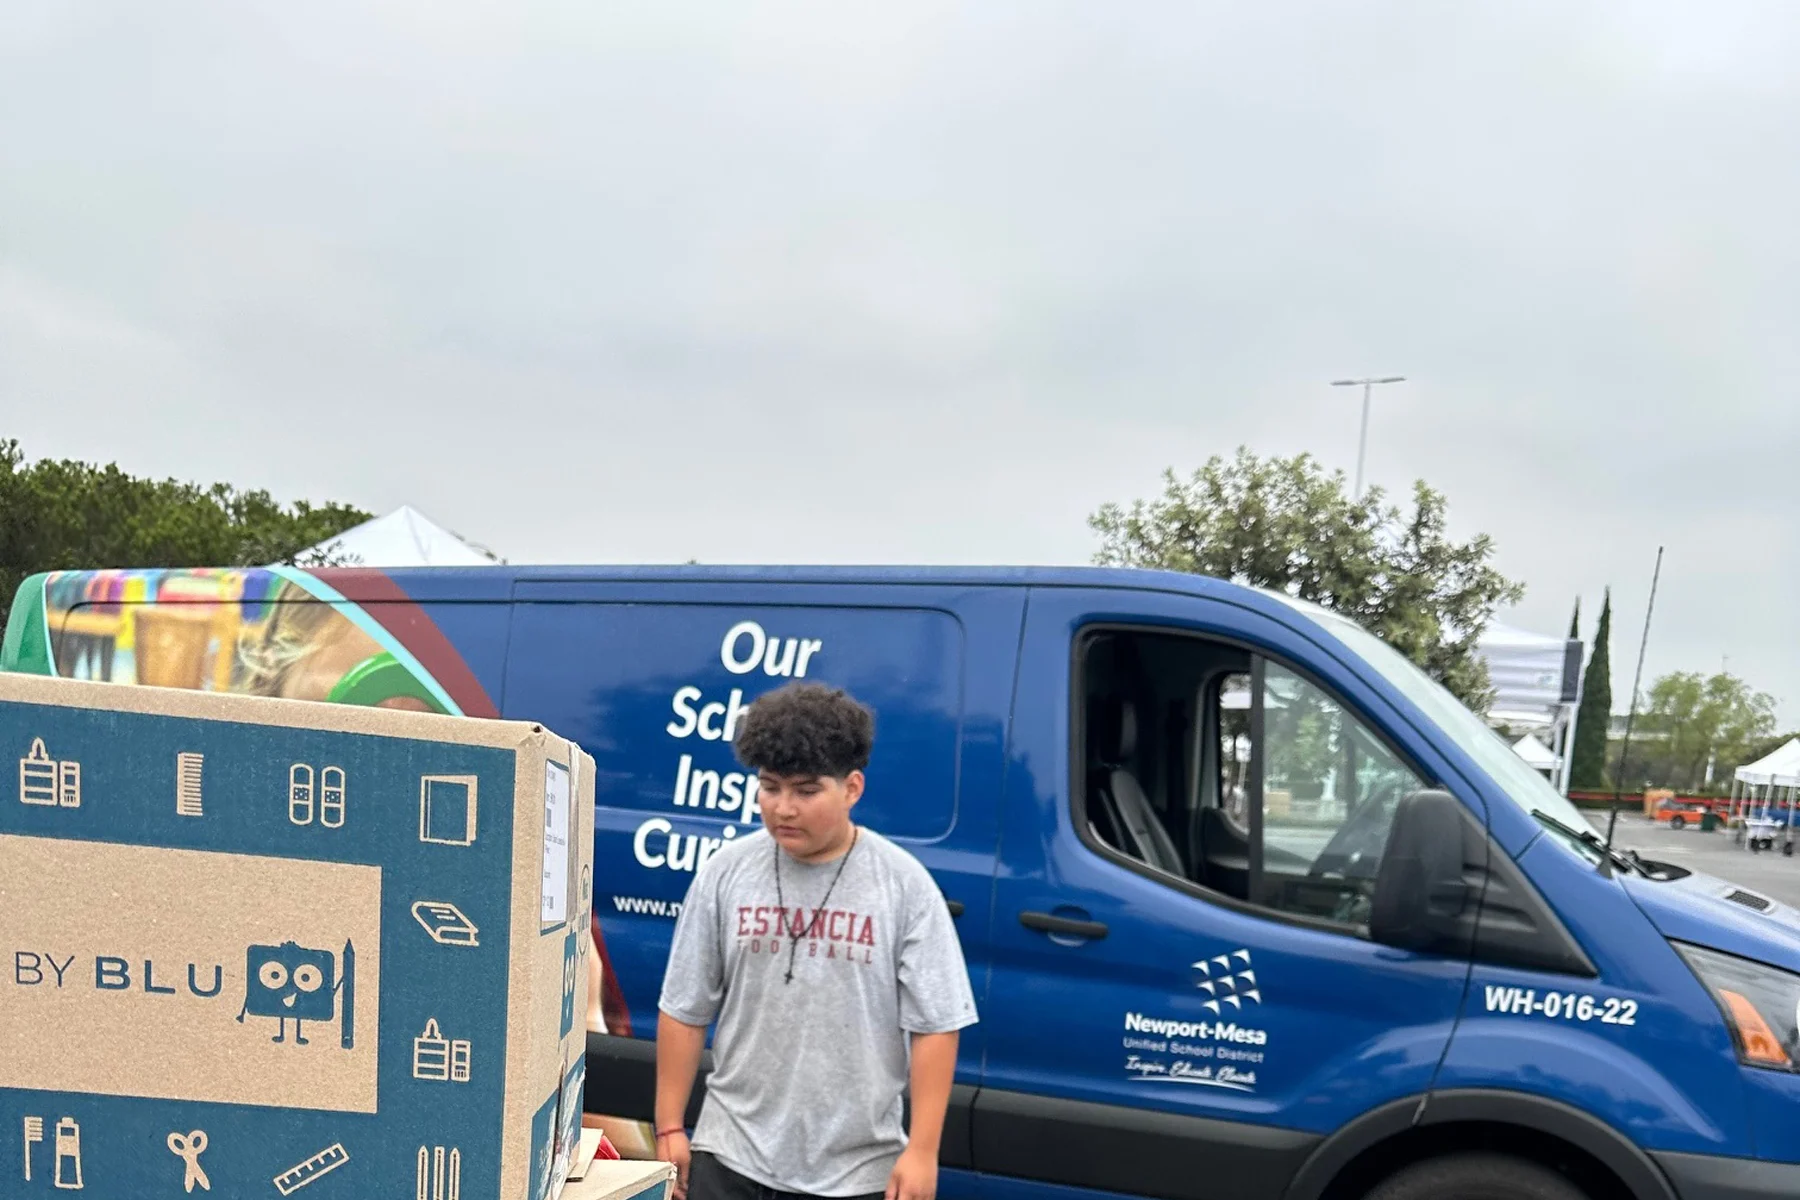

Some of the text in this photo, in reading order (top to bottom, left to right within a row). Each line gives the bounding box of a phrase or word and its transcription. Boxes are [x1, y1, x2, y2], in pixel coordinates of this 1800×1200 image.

[721, 620, 822, 678] Our
[737, 906, 875, 946] ESTANCIA
[737, 938, 873, 965] OOBALL
[15, 951, 223, 998] BY BLU
[1485, 985, 1638, 1026] WH-016-22
[1124, 1011, 1268, 1046] Newport-Mesa
[1122, 1036, 1265, 1064] Unified School District
